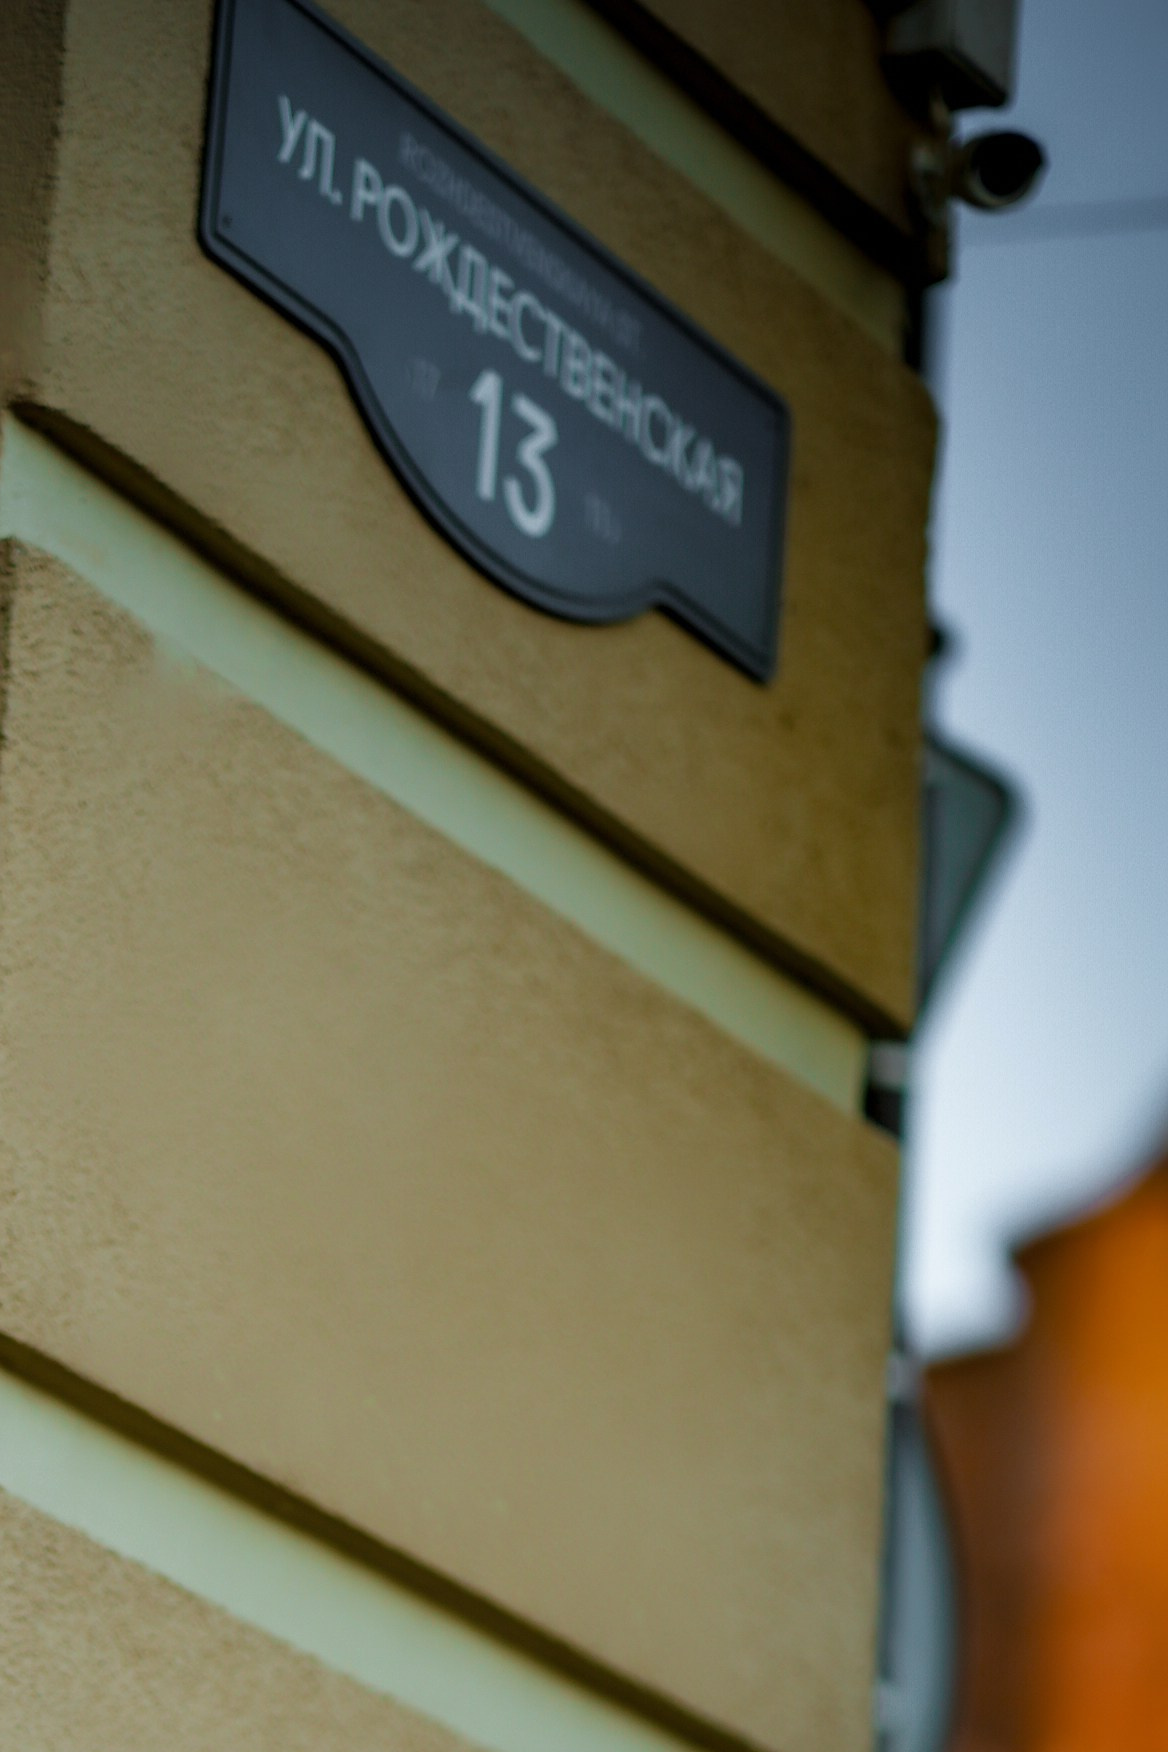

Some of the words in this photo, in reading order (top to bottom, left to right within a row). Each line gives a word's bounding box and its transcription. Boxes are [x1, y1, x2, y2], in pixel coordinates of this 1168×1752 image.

[277, 95, 343, 205] УЛ.
[351, 157, 745, 528] РОЖДЕСТВЕНСКАЯ
[470, 370, 559, 539] 13
